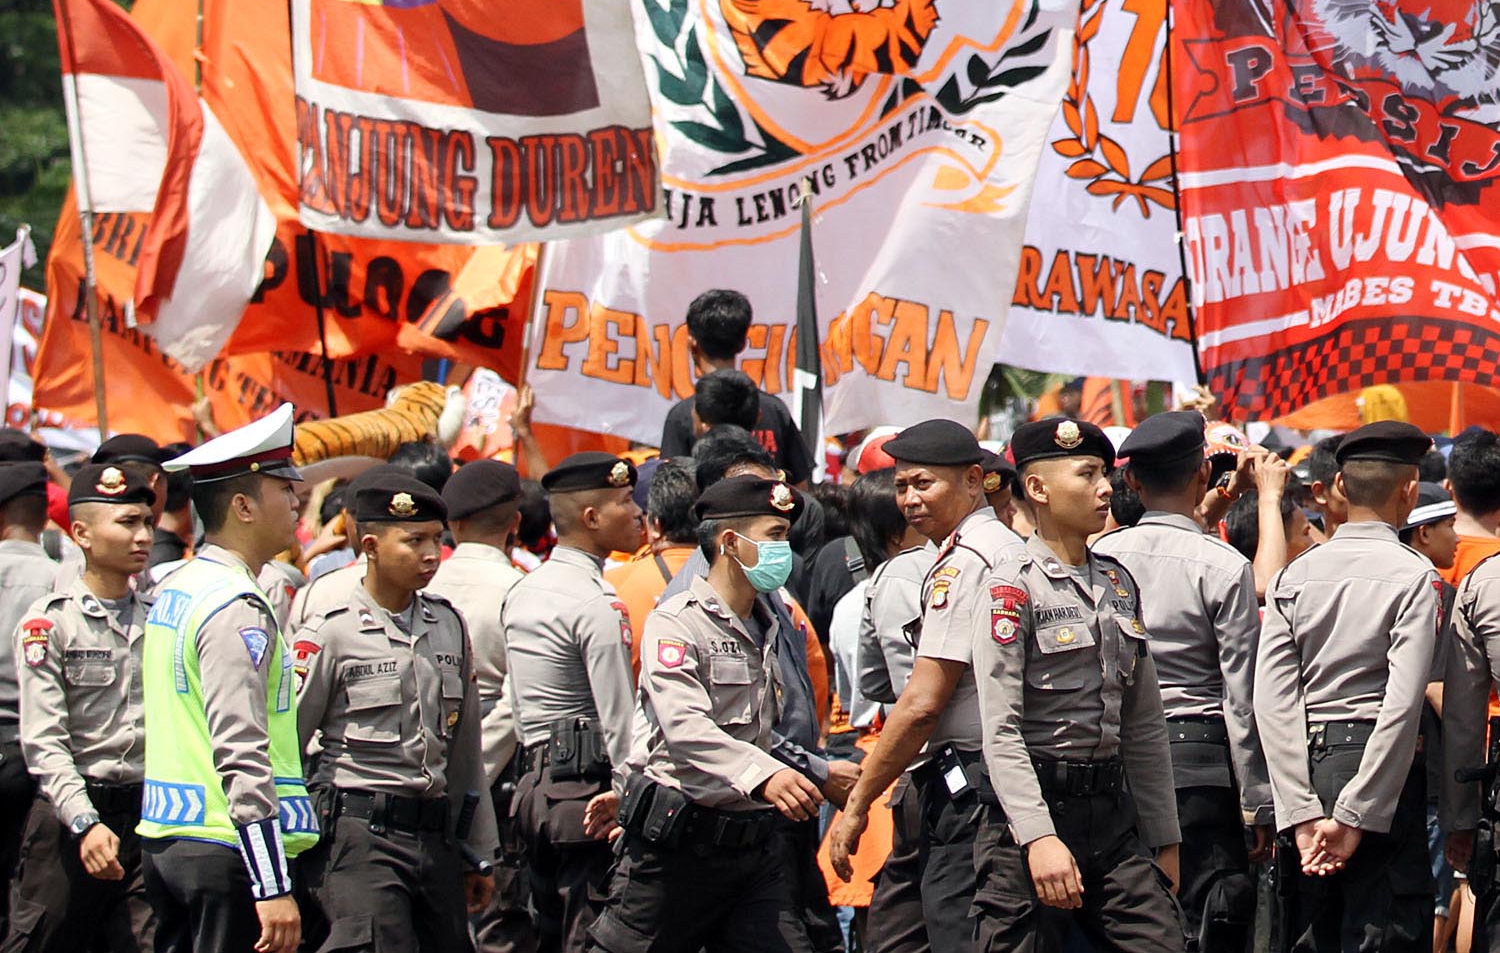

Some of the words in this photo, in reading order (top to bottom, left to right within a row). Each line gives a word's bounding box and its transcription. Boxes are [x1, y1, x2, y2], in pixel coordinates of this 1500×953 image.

[297, 96, 478, 232] ANJUNG
[486, 124, 656, 231] DUREN
[377, 660, 397, 674] AZIZ
